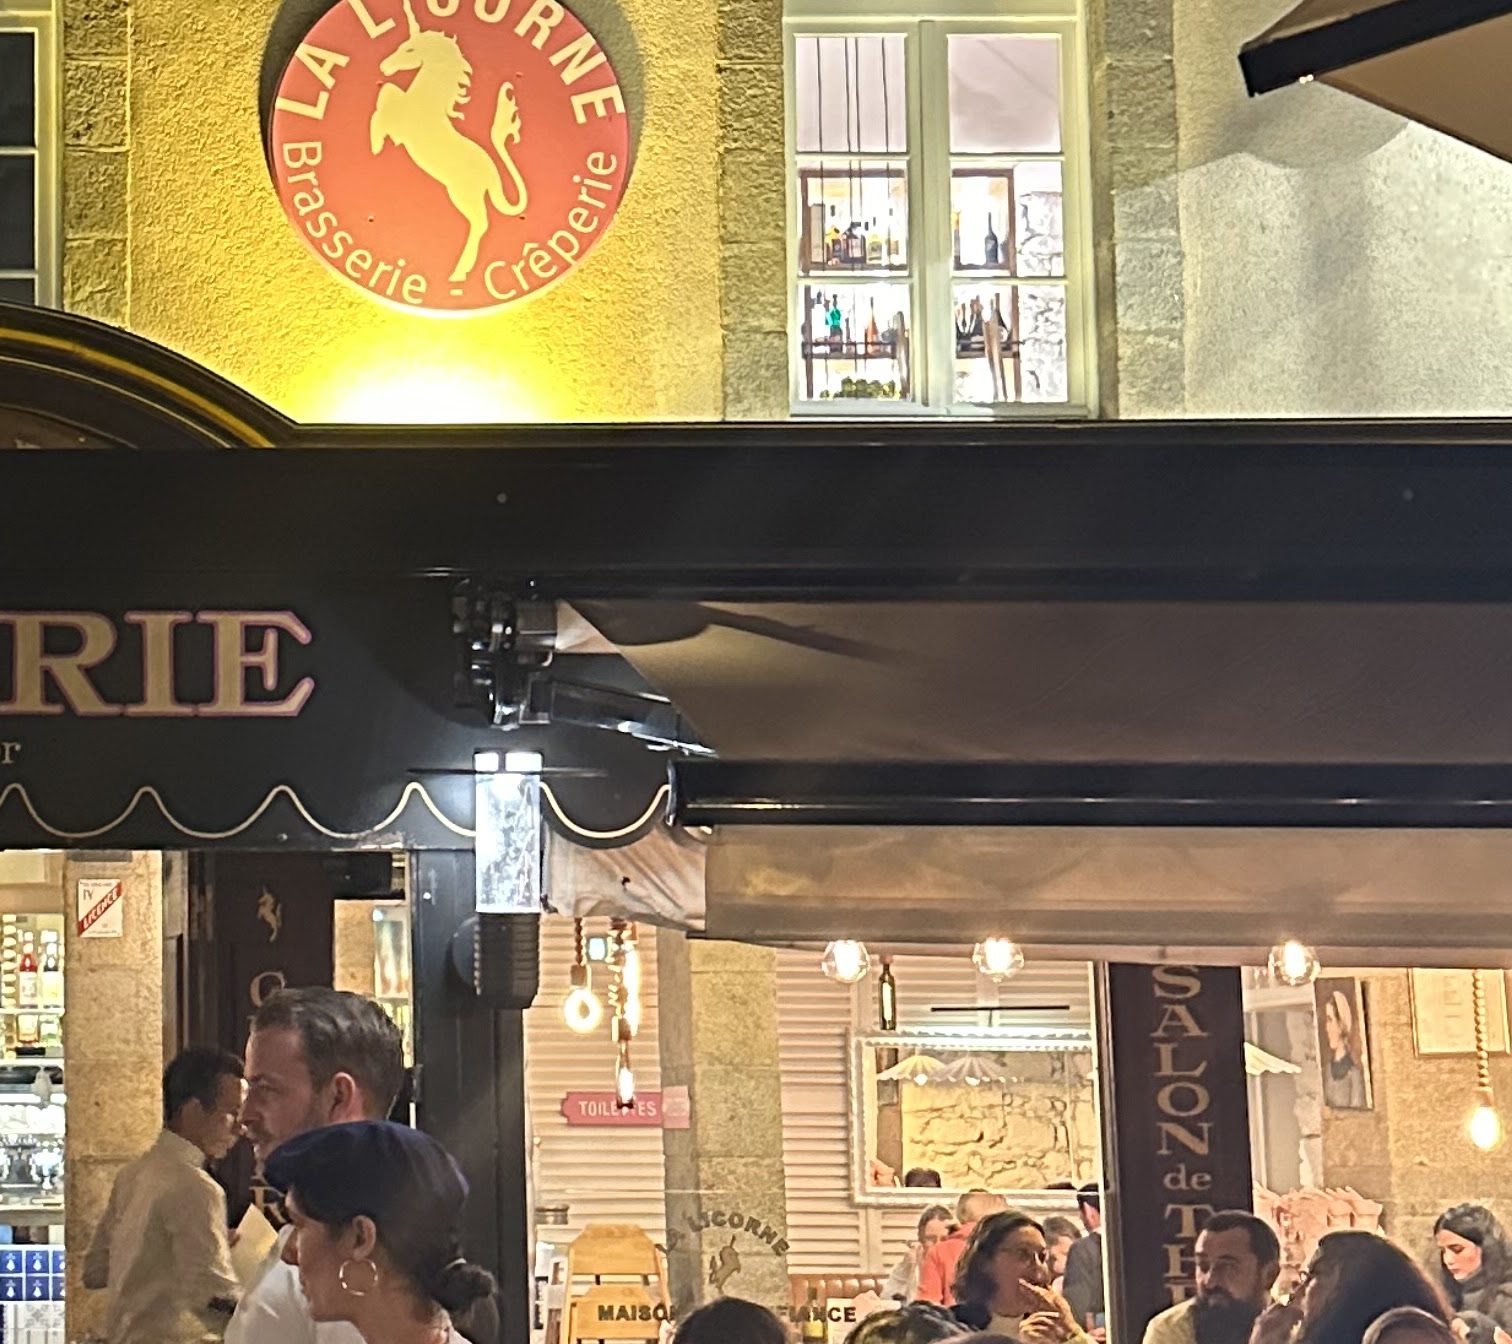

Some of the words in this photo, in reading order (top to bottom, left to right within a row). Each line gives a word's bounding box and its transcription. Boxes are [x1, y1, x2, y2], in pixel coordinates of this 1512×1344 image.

[275, 42, 350, 120] LA
[283, 141, 428, 305] Brasserie
[483, 150, 618, 301] Crêperie
[1150, 965, 1214, 1155] SALON
[578, 1100, 658, 1116] TOILEES
[1163, 1164, 1212, 1190] de
